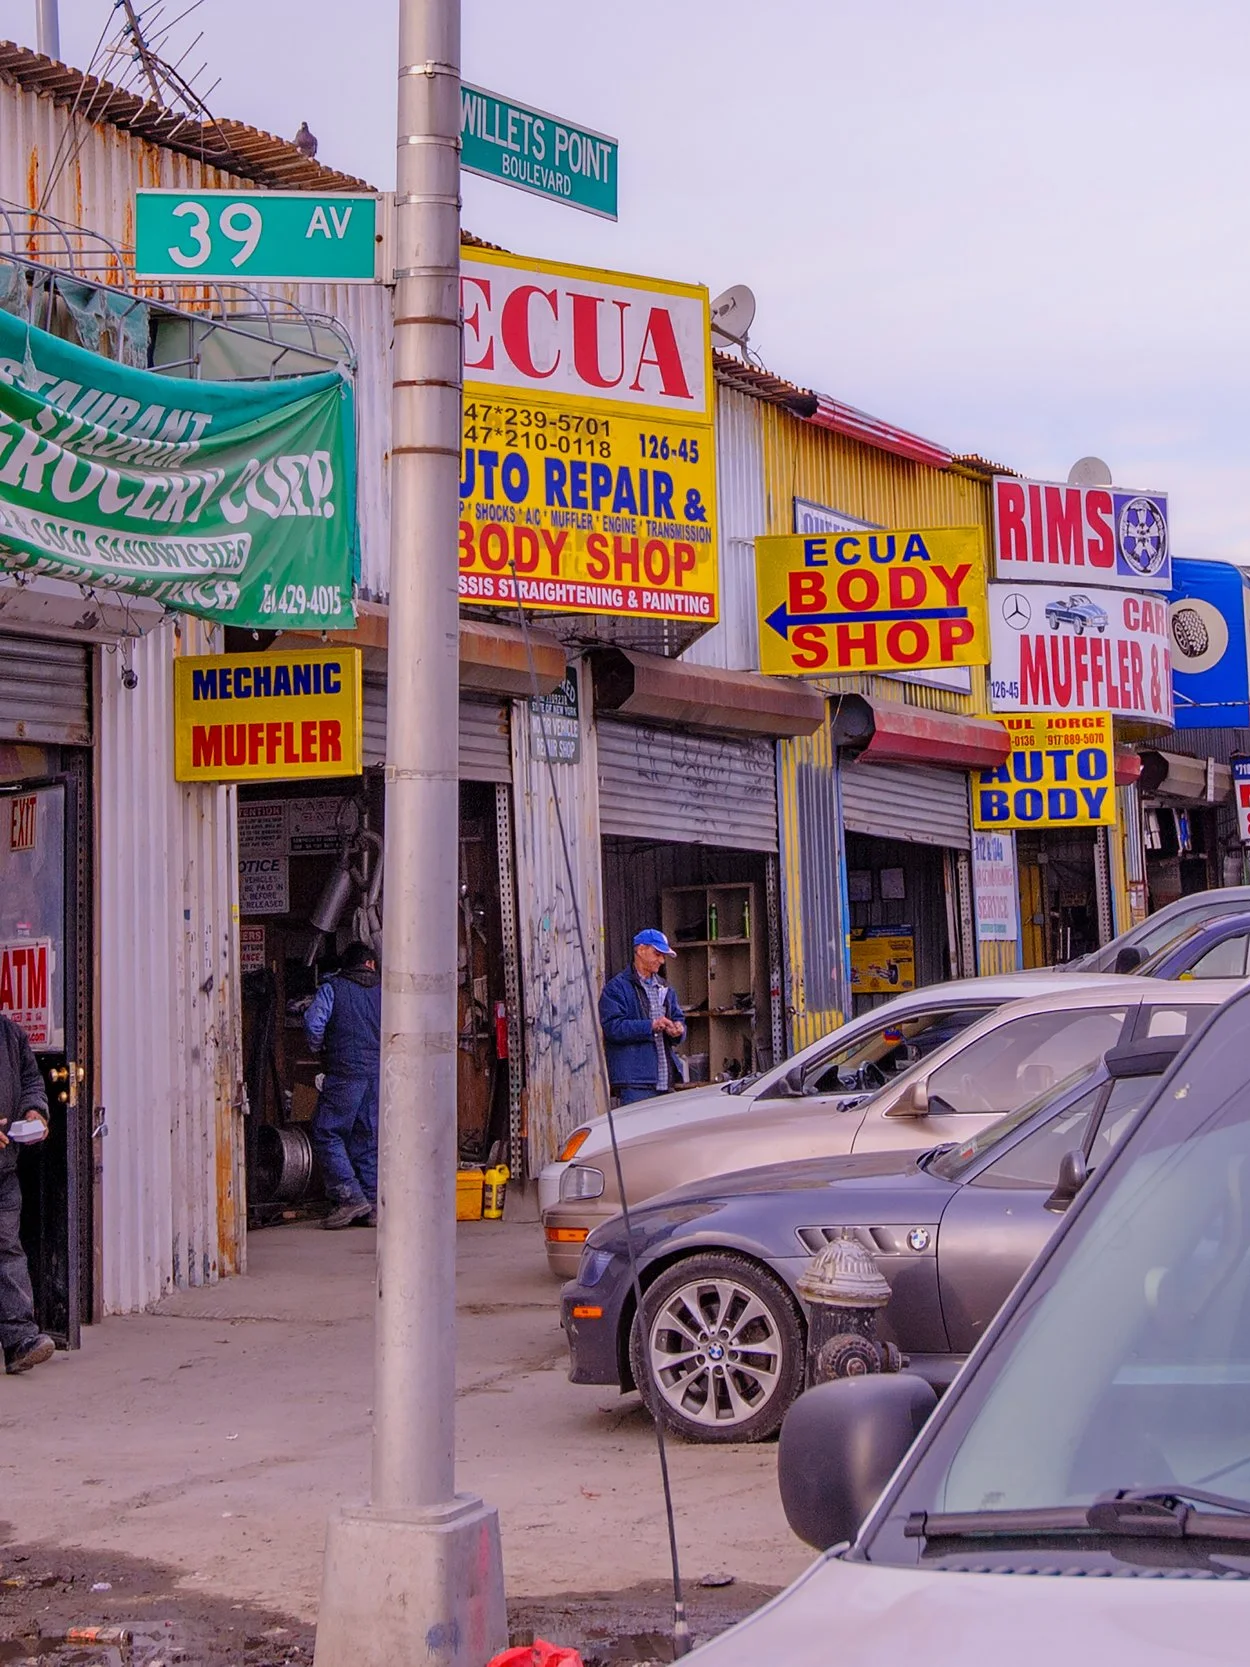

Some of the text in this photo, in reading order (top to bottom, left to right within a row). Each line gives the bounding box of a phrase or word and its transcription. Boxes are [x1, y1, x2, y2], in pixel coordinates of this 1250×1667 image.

[460, 90, 611, 184] WILLETS POINT
[502, 153, 571, 196] BOULEVARD
[168, 201, 353, 268] 39 AV
[460, 277, 694, 400] ECUA
[639, 433, 699, 465] 126-45
[459, 448, 709, 522] UTO REPAIR &
[476, 502, 515, 523] SHOCKS
[551, 510, 593, 531] MUFFLER
[603, 515, 636, 535] ENGINE
[646, 520, 711, 543] TRANSMISSION
[997, 482, 1114, 569] RIMS
[95, 534, 247, 569] SANDWICHES
[459, 521, 696, 587] BODY SHOP
[804, 533, 931, 568] ECUA
[458, 575, 710, 614] SSIS STRAIGHTENING & PAINTING
[788, 563, 973, 614] BODY
[791, 619, 975, 668] SHOP
[192, 662, 342, 701] MECHANIC
[991, 681, 1019, 699] 126-45
[1020, 634, 1145, 711] MUFFLER
[1151, 644, 1163, 714] &
[192, 719, 342, 768] MUFFLER
[1046, 717, 1105, 729] JORGE
[979, 748, 1108, 784] AUTO
[10, 794, 37, 848] EXIT
[980, 787, 1108, 822] BODY
[239, 859, 280, 873] OTICE
[0, 947, 46, 1010] ATM
